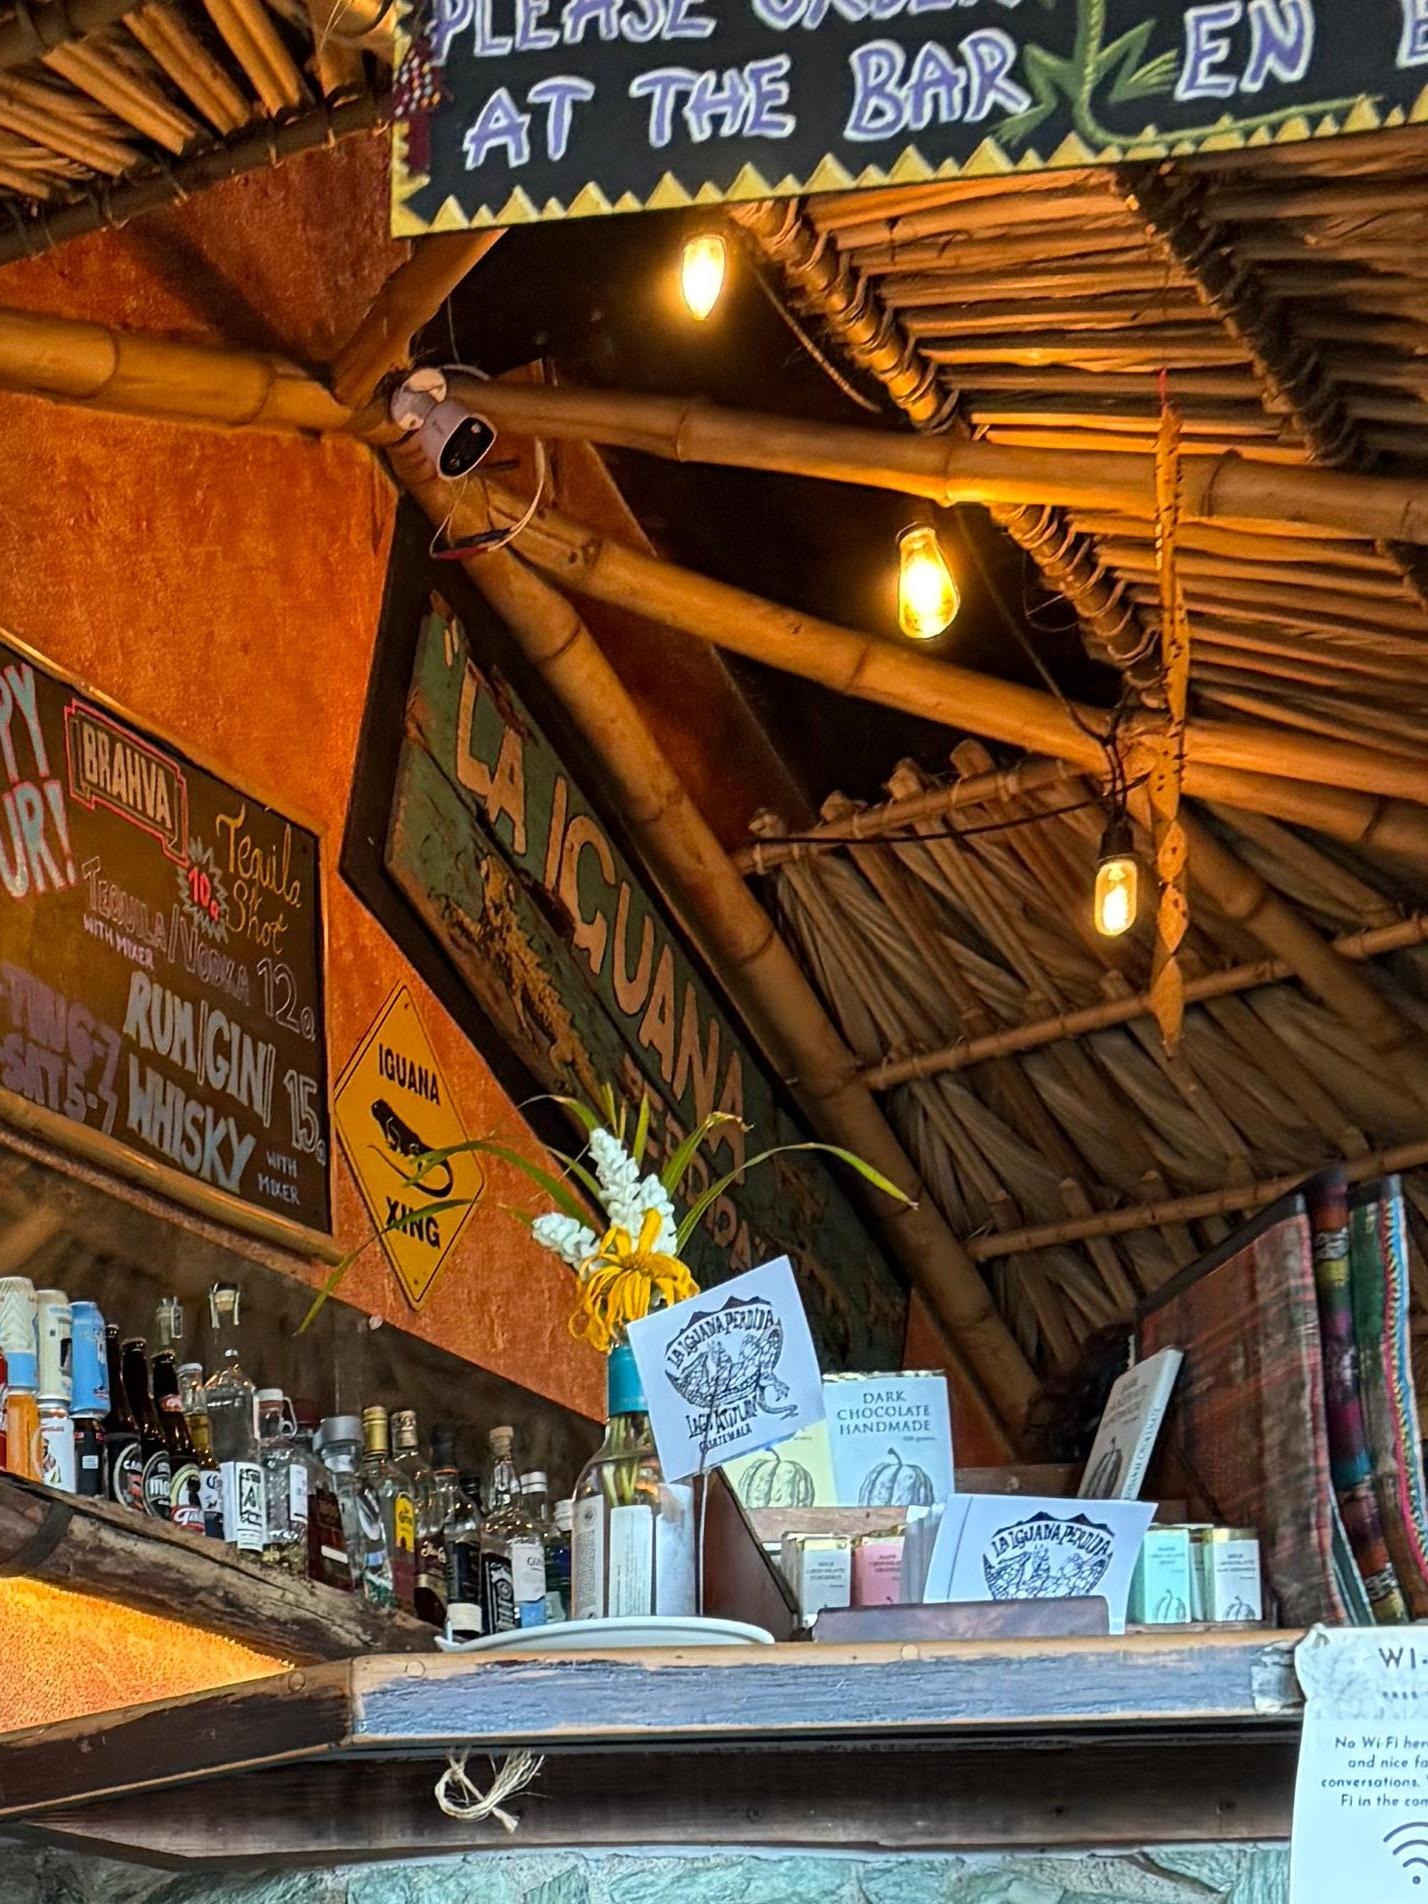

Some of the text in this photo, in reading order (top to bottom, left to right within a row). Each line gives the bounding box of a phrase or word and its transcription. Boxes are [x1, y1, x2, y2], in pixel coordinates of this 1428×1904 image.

[1174, 0, 1315, 101] EN
[463, 28, 1032, 170] AT THE BAR
[81, 724, 172, 829] BRAHVA
[457, 657, 527, 856] LA
[545, 774, 744, 1186] IGUANA
[378, 1043, 441, 1106] IGUANA
[127, 1052, 257, 1194] WHISKY
[266, 1151, 299, 1178] WITH
[258, 1173, 300, 1206] MIXER
[386, 1196, 441, 1249] XING
[836, 1404, 931, 1421] CHOCOLATE
[863, 1390, 907, 1404] DARK
[839, 1420, 932, 1436] HANDMADE
[990, 1522, 1112, 1558] LA IGUANA PERDIDA
[1335, 1736, 1356, 1749] No
[1348, 1754, 1375, 1769] and
[1380, 1755, 1409, 1769] nice
[1321, 1777, 1421, 1789] conversations.
[1358, 1794, 1372, 1807] in
[1376, 1793, 1399, 1807] the
